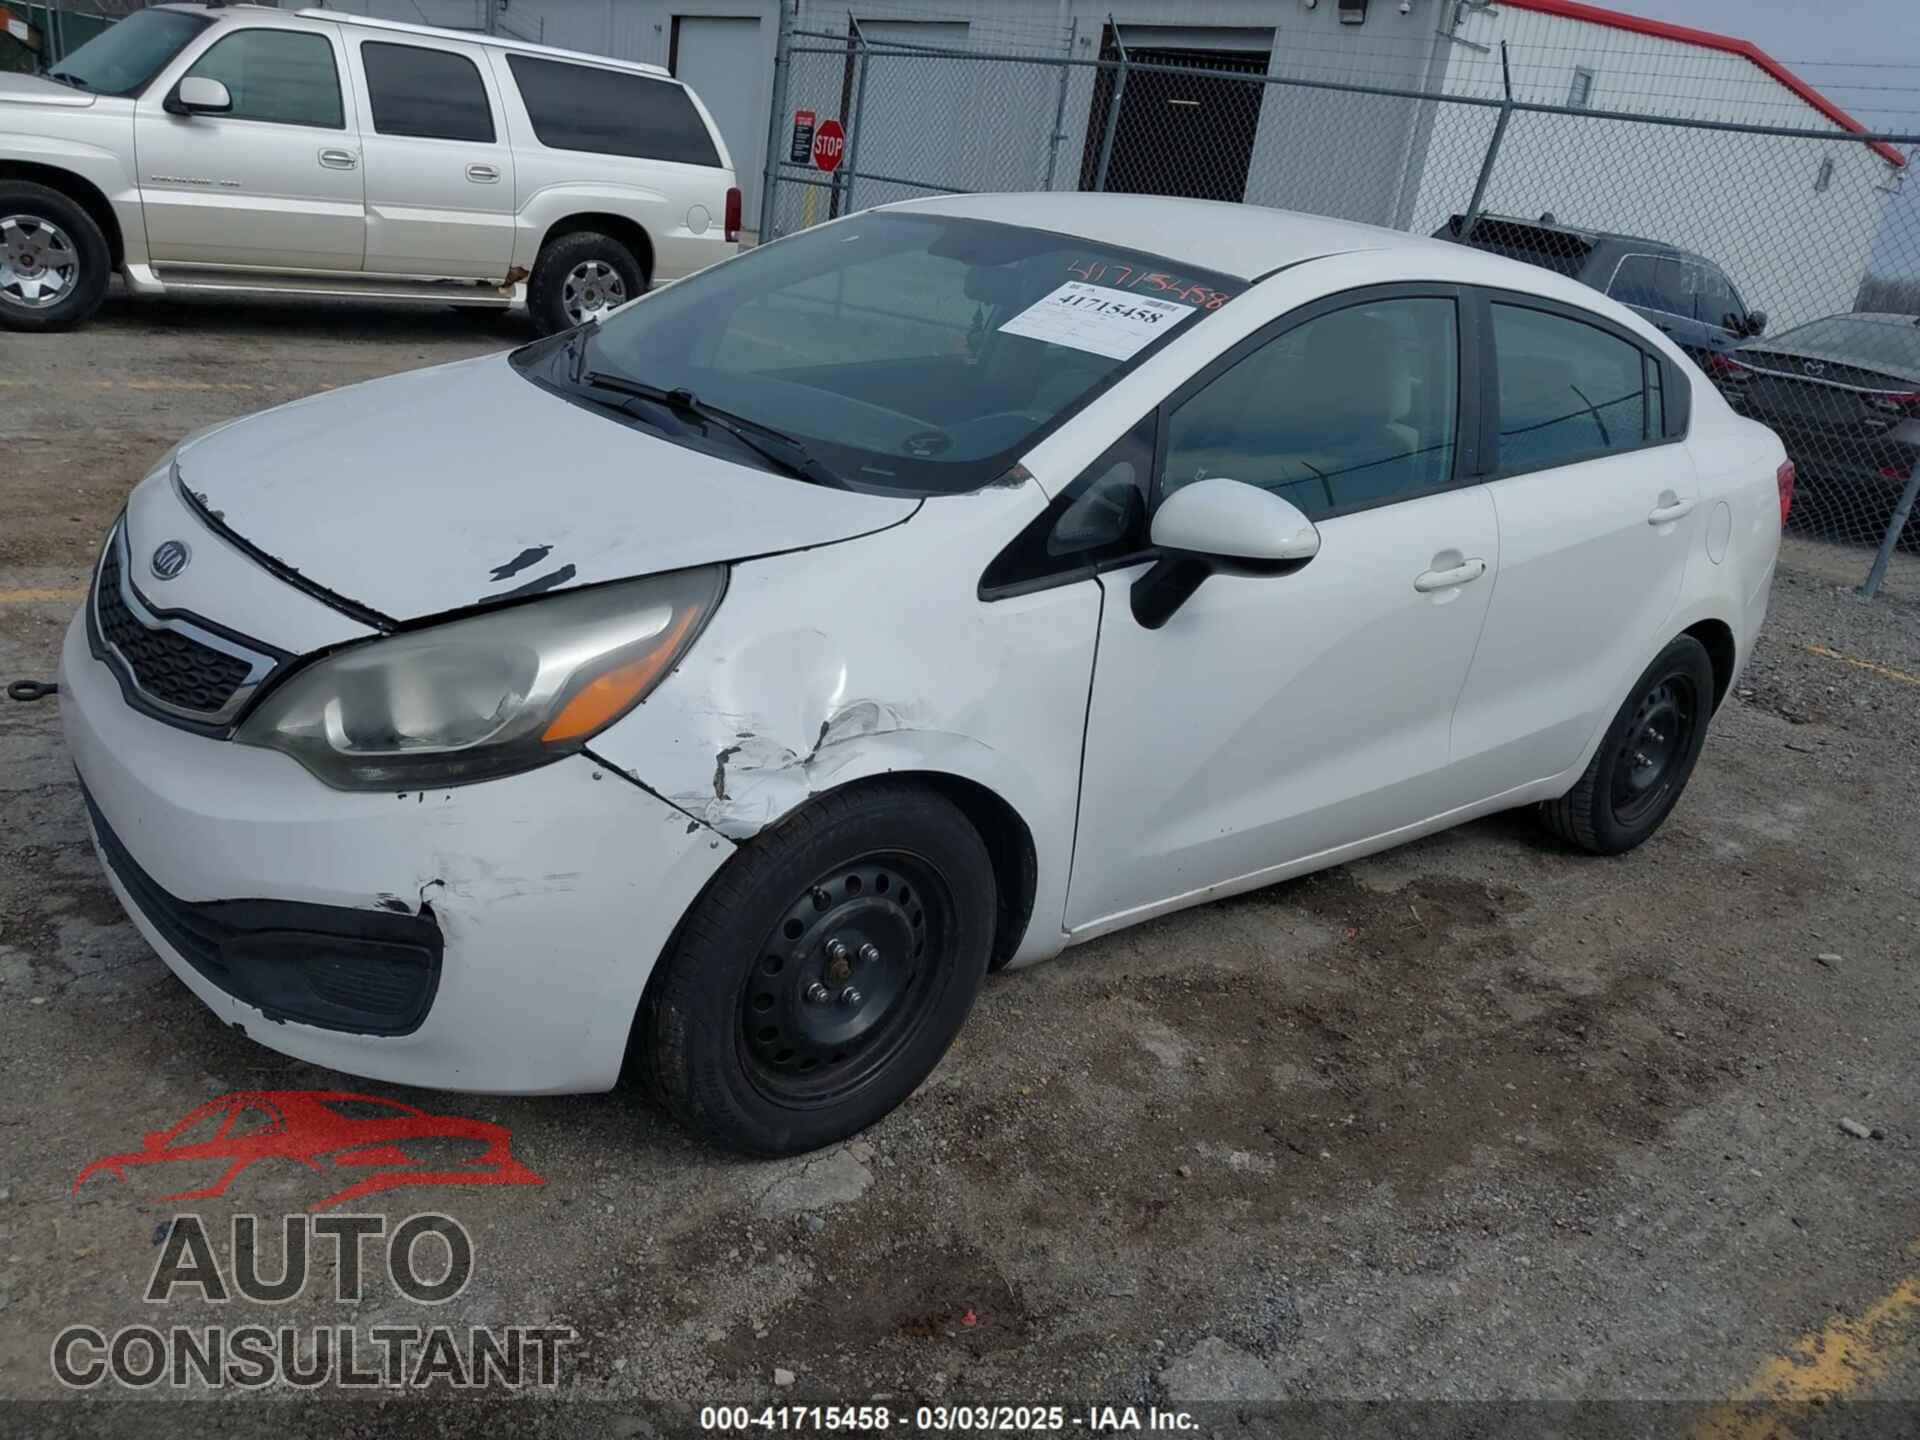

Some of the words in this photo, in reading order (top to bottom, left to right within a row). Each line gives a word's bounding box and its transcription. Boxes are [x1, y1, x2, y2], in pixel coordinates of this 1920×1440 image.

[815, 135, 843, 156] STOP
[1068, 259, 1232, 309] 41715458
[1059, 294, 1164, 324] 41715458
